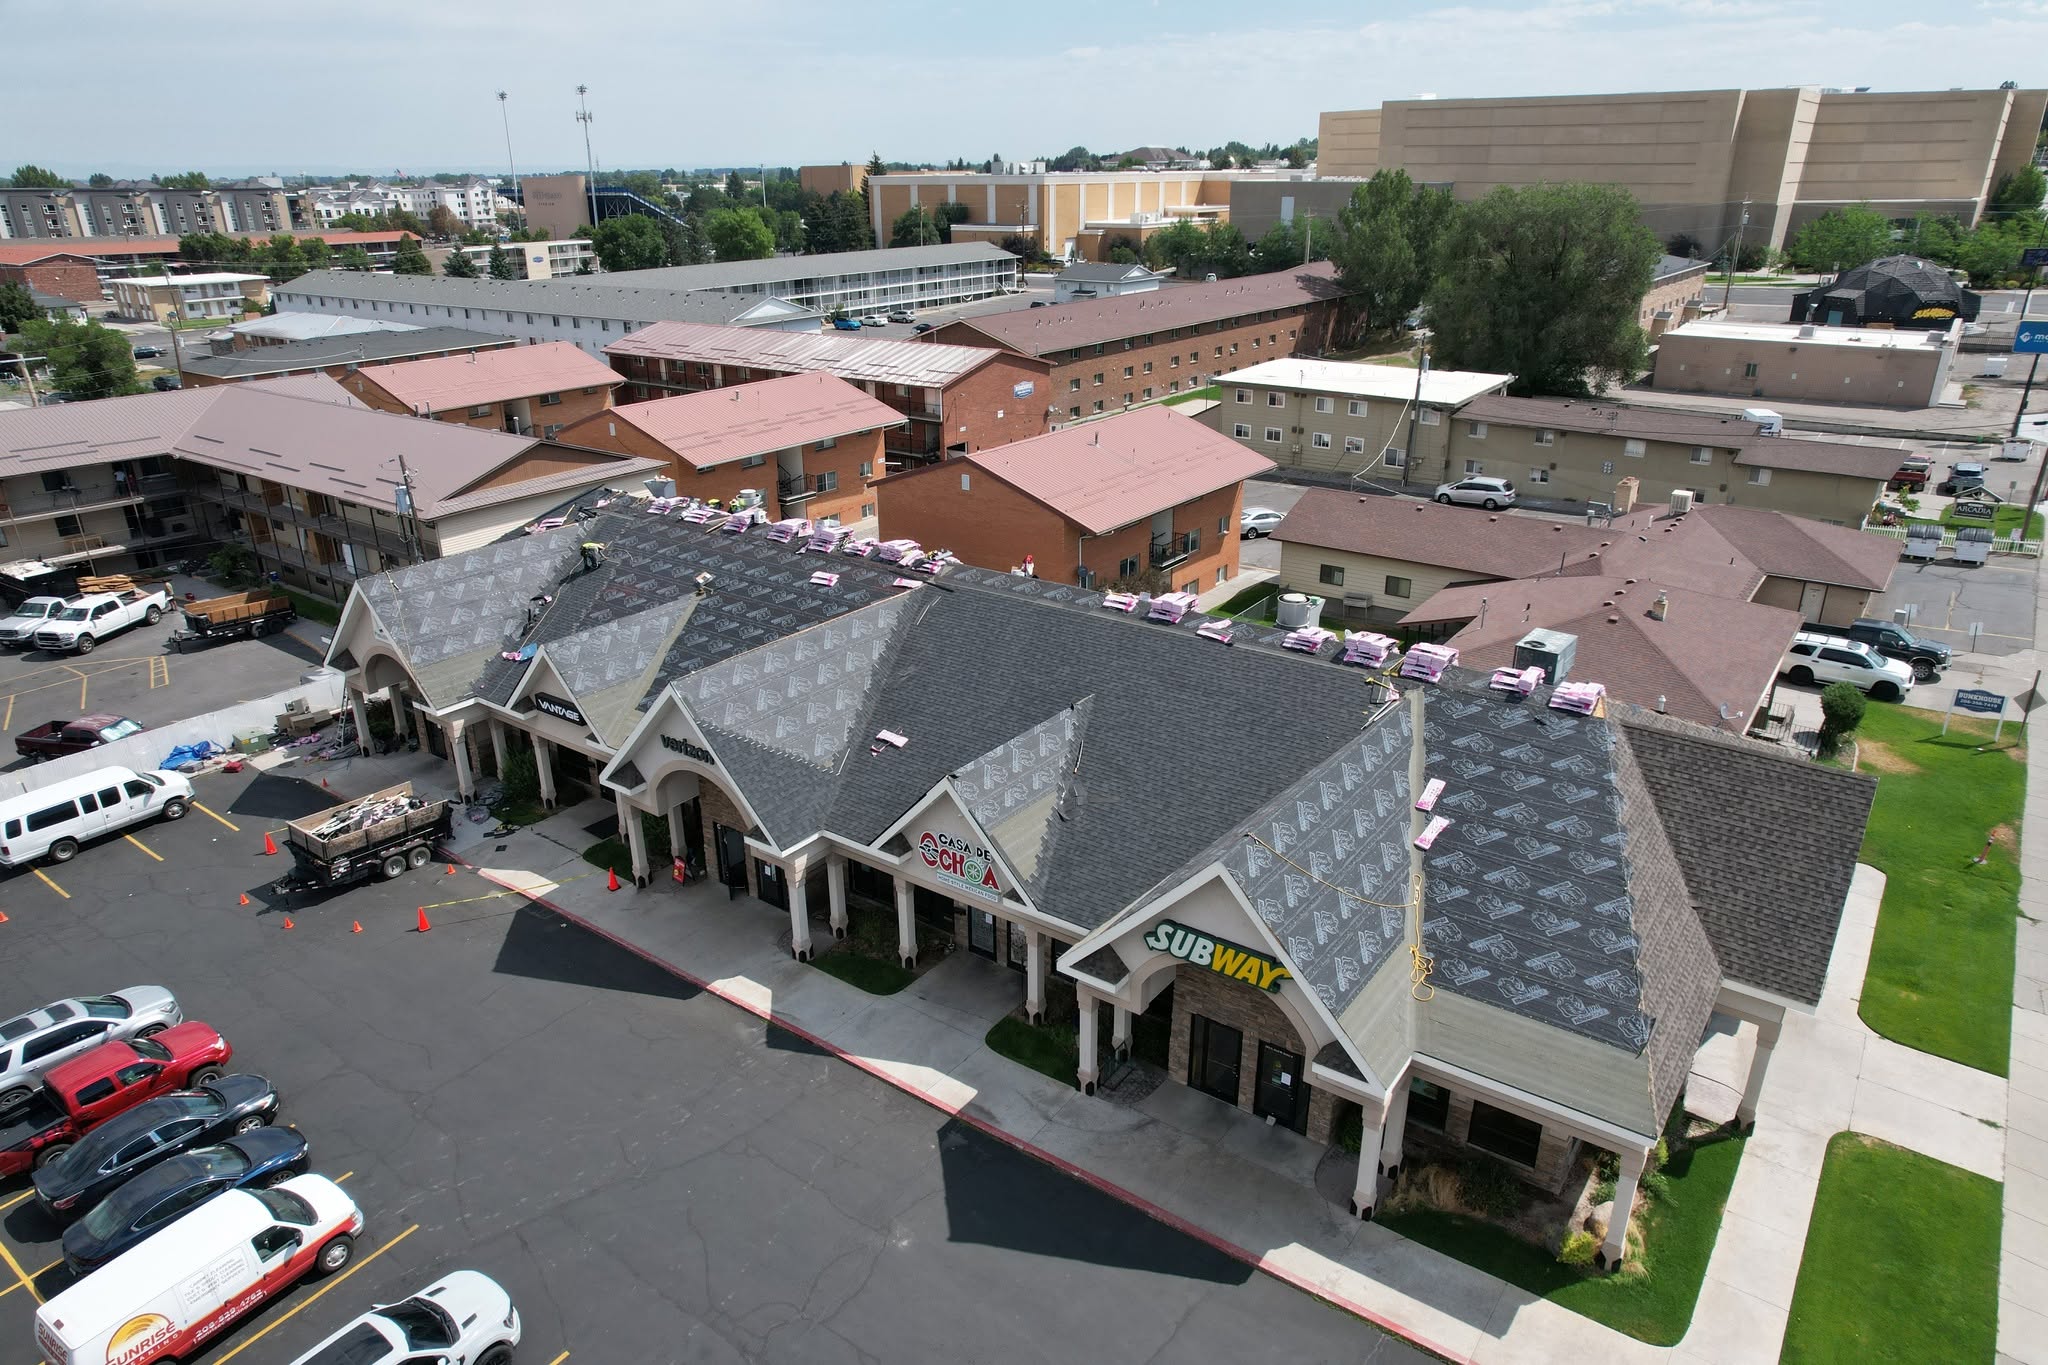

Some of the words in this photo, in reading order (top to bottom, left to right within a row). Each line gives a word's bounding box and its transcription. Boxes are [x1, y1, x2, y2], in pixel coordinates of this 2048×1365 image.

[1957, 505, 1992, 515] ARCADIA
[538, 699, 580, 722] VANTAGE
[660, 734, 715, 765] verizon
[919, 831, 1001, 891] OCHOA
[938, 833, 972, 855] CASA
[976, 847, 991, 862] DE
[1146, 924, 1292, 989] SUBWAY
